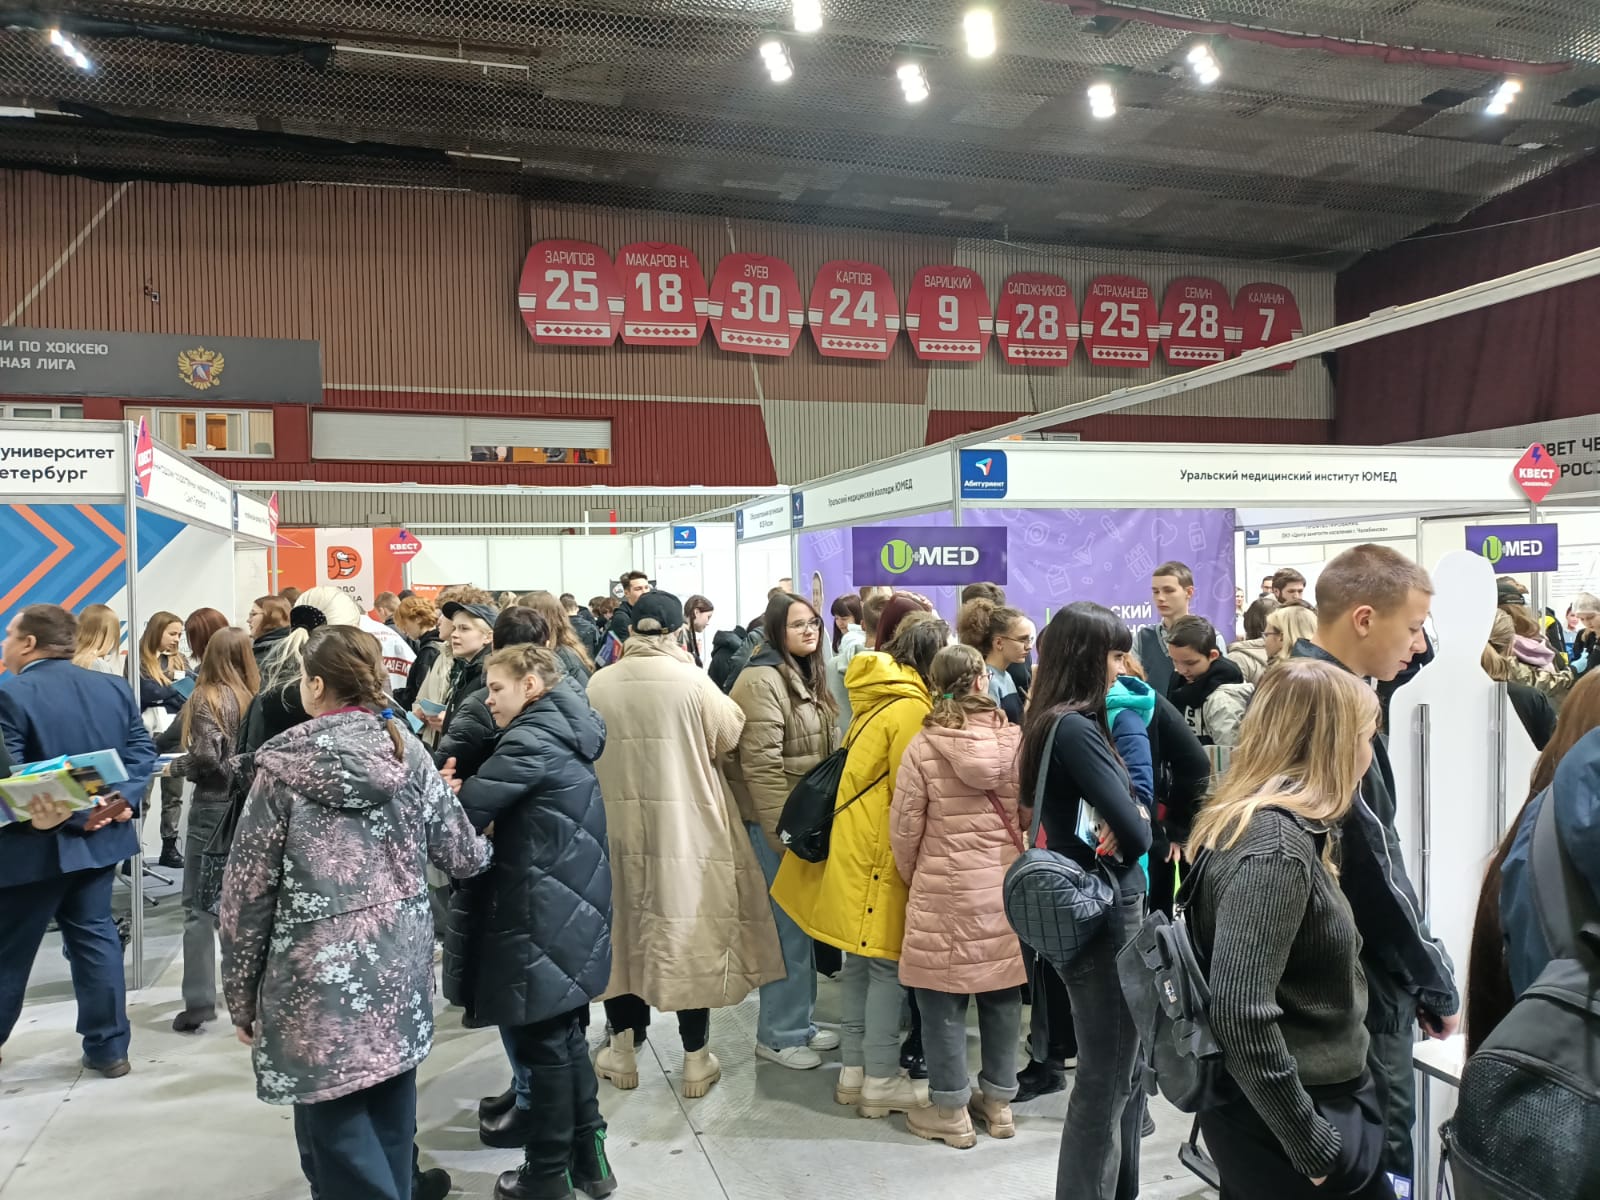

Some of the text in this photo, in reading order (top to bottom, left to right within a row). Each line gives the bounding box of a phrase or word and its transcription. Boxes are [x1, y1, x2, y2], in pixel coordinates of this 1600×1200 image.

[545, 250, 595, 266] ЗАРИПОВ
[625, 252, 677, 268] МАКАРОВ
[744, 264, 769, 279] ЗУЕВ
[836, 271, 872, 286] КАРПОВ
[924, 273, 972, 290] ВАРИЦКИЙ
[1008, 281, 1067, 297] САПОЖНИКОВ
[544, 269, 599, 311] 25
[635, 272, 683, 312] 18
[1092, 284, 1149, 300] АСТРАХАНЦЕВ
[731, 281, 781, 323] 30
[1248, 292, 1285, 305] КАЛИНИН
[829, 288, 878, 328] 24
[938, 295, 959, 331] 9
[1015, 303, 1058, 341] 28
[1100, 301, 1140, 339] 25
[1178, 303, 1218, 339] 28
[1259, 308, 1275, 341] 7
[0, 340, 108, 355] И ПО ХОККЕЮ
[0, 357, 76, 370] НАЯ ЛИГА
[0, 448, 115, 462] университет
[1541, 440, 1576, 456] ВЕТ
[0, 465, 88, 483] етербург
[1180, 469, 1397, 483] Уральский медицинский институт ЮМЕД
[1519, 468, 1555, 479] КВЕСТ
[1557, 460, 1600, 478] РОС
[895, 478, 913, 491] ЮМЕД
[964, 480, 1004, 488] Абитуриент
